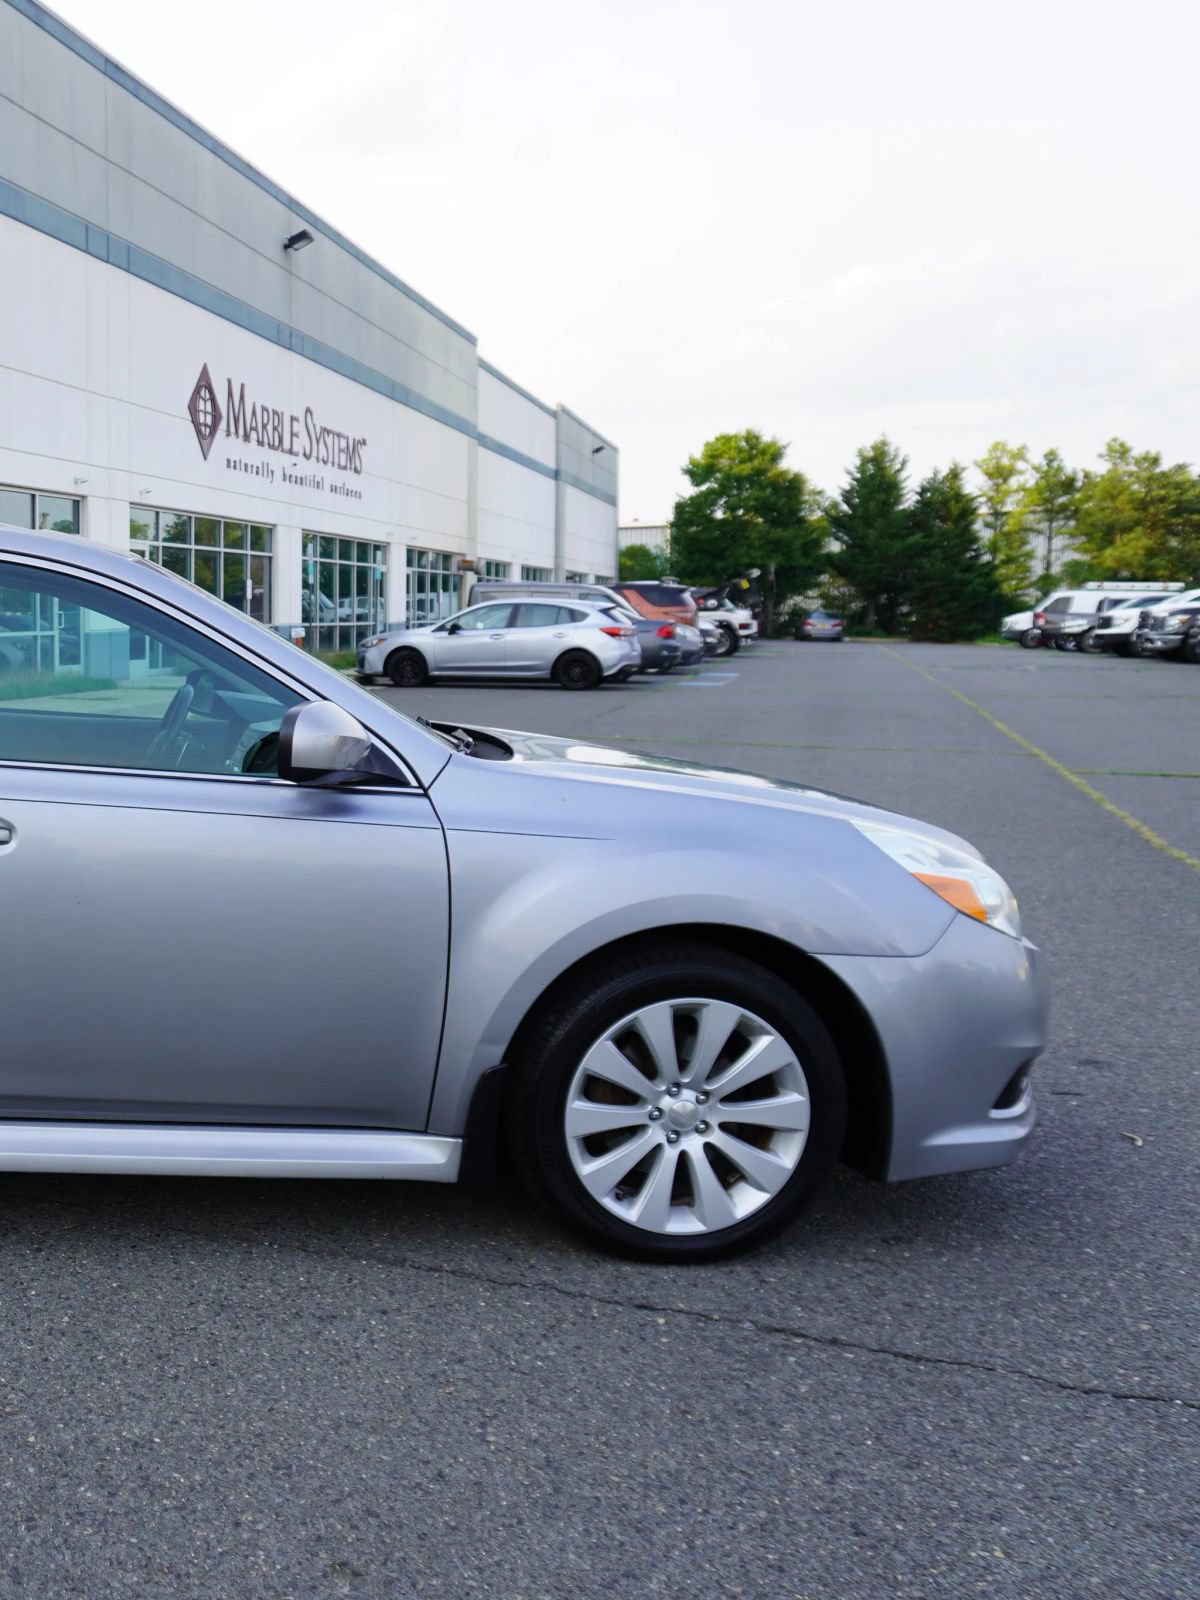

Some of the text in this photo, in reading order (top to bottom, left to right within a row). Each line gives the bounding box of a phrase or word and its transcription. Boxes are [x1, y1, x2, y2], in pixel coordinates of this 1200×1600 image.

[226, 377, 300, 457] MARBLE
[226, 458, 362, 499] naturally beautiful surfaces
